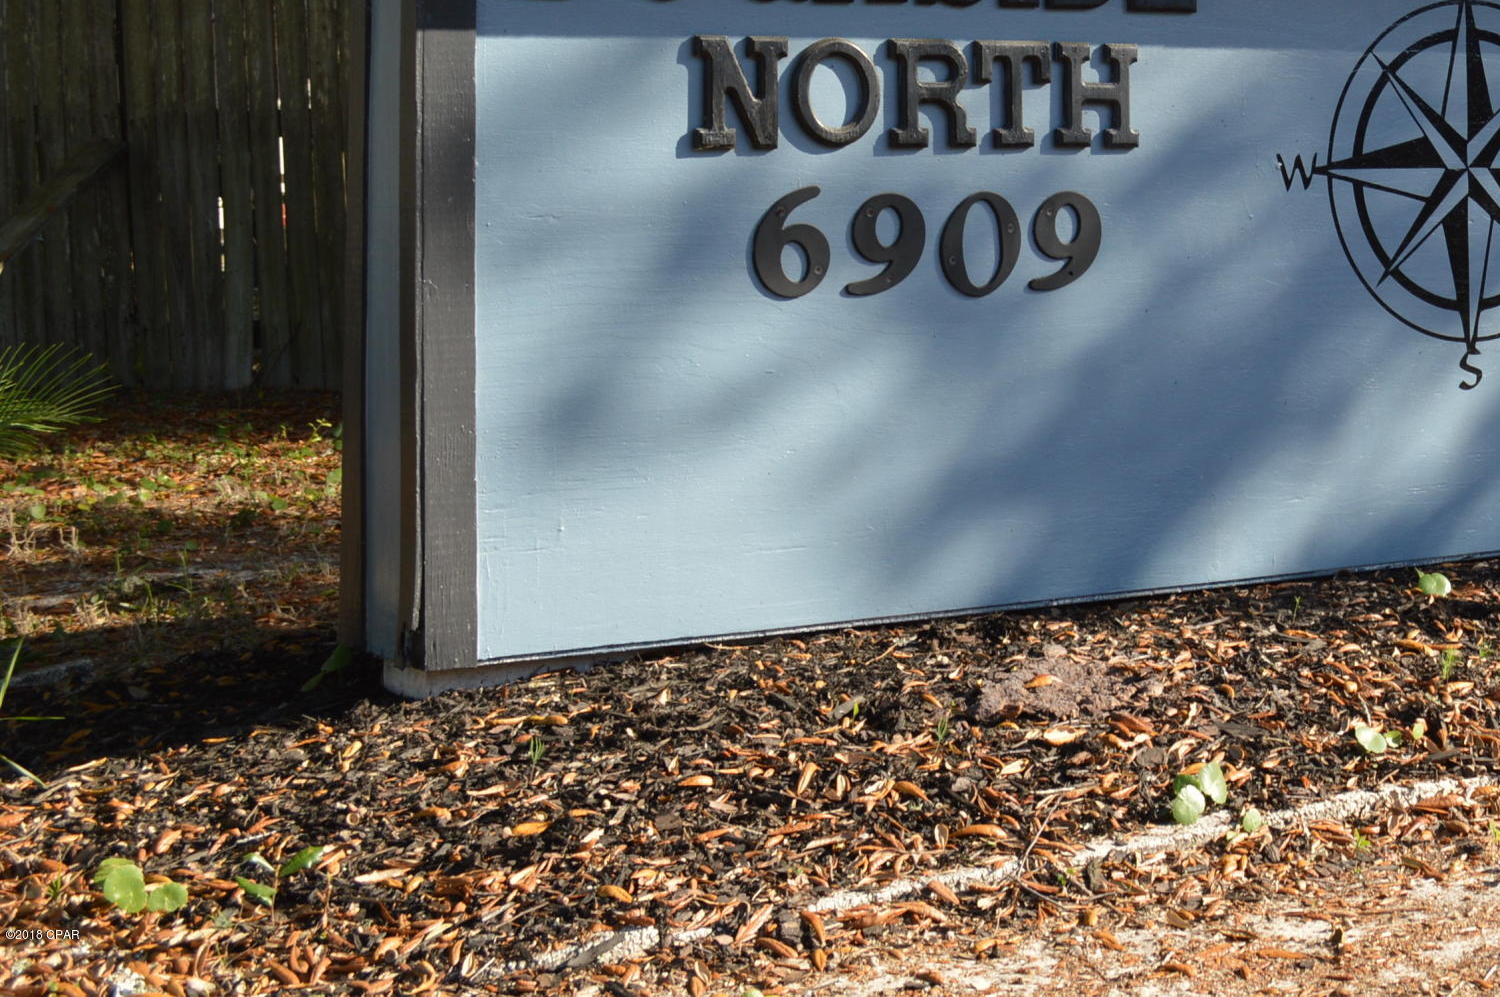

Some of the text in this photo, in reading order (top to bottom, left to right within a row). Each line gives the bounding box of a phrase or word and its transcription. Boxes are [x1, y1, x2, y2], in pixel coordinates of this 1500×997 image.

[692, 34, 1140, 150] NORTH
[1276, 153, 1318, 192] W
[753, 185, 1102, 299] 6909
[1458, 349, 1482, 390] S
